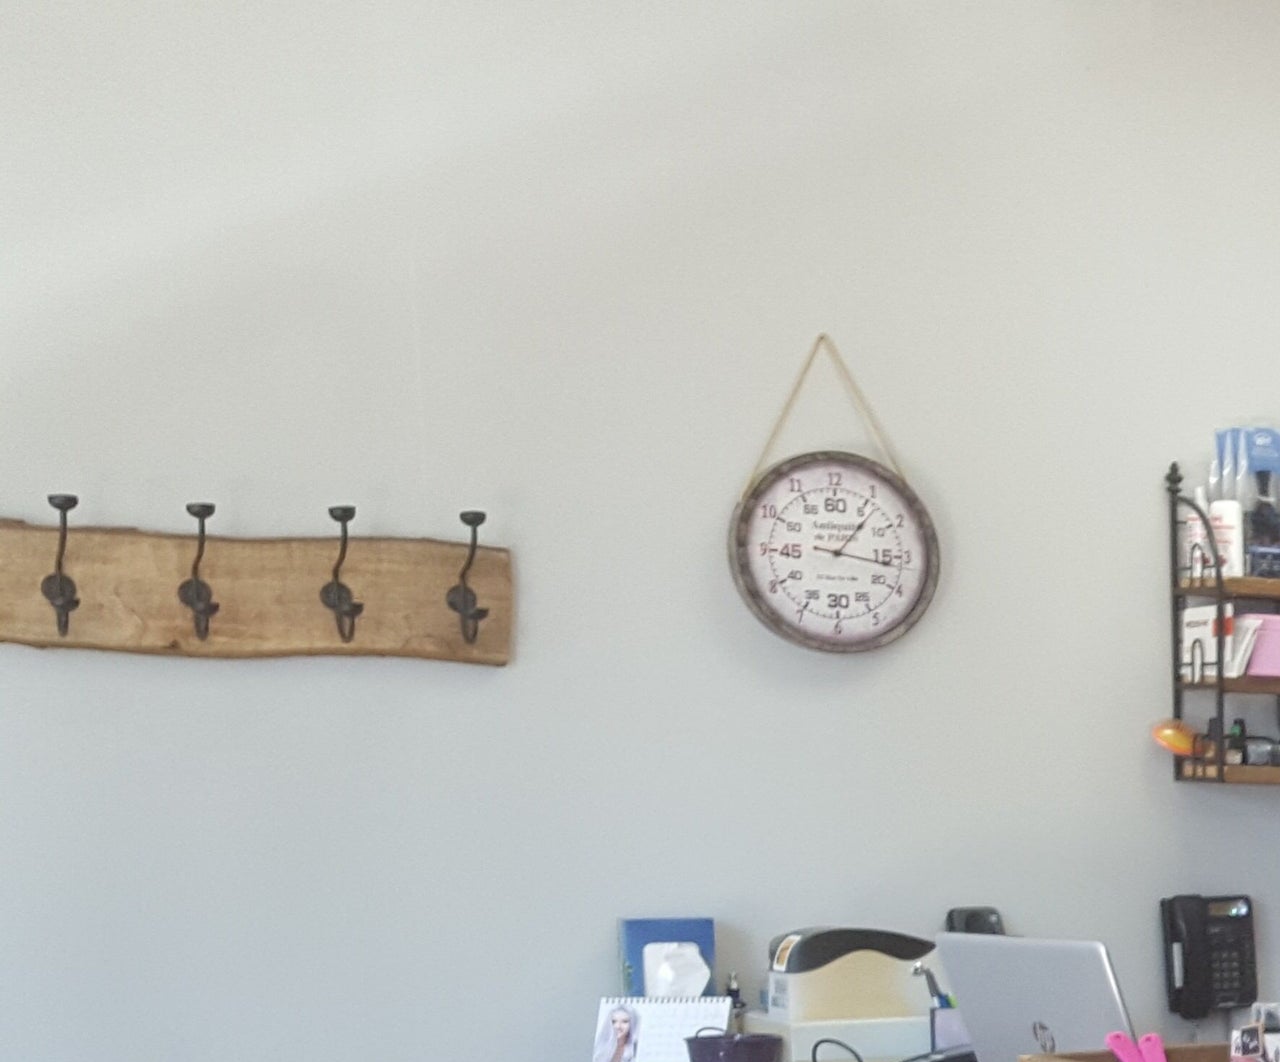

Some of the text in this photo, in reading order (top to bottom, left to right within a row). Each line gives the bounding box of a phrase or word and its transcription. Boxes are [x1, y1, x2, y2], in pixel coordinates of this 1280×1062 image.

[790, 478, 802, 493] 11
[828, 473, 842, 486] 12
[761, 504, 777, 519] 10
[824, 497, 848, 514] 60
[896, 514, 905, 528] 2
[780, 544, 802, 560] 45
[904, 551, 912, 565] 3
[827, 594, 849, 609] 30
[872, 612, 879, 626] 5
